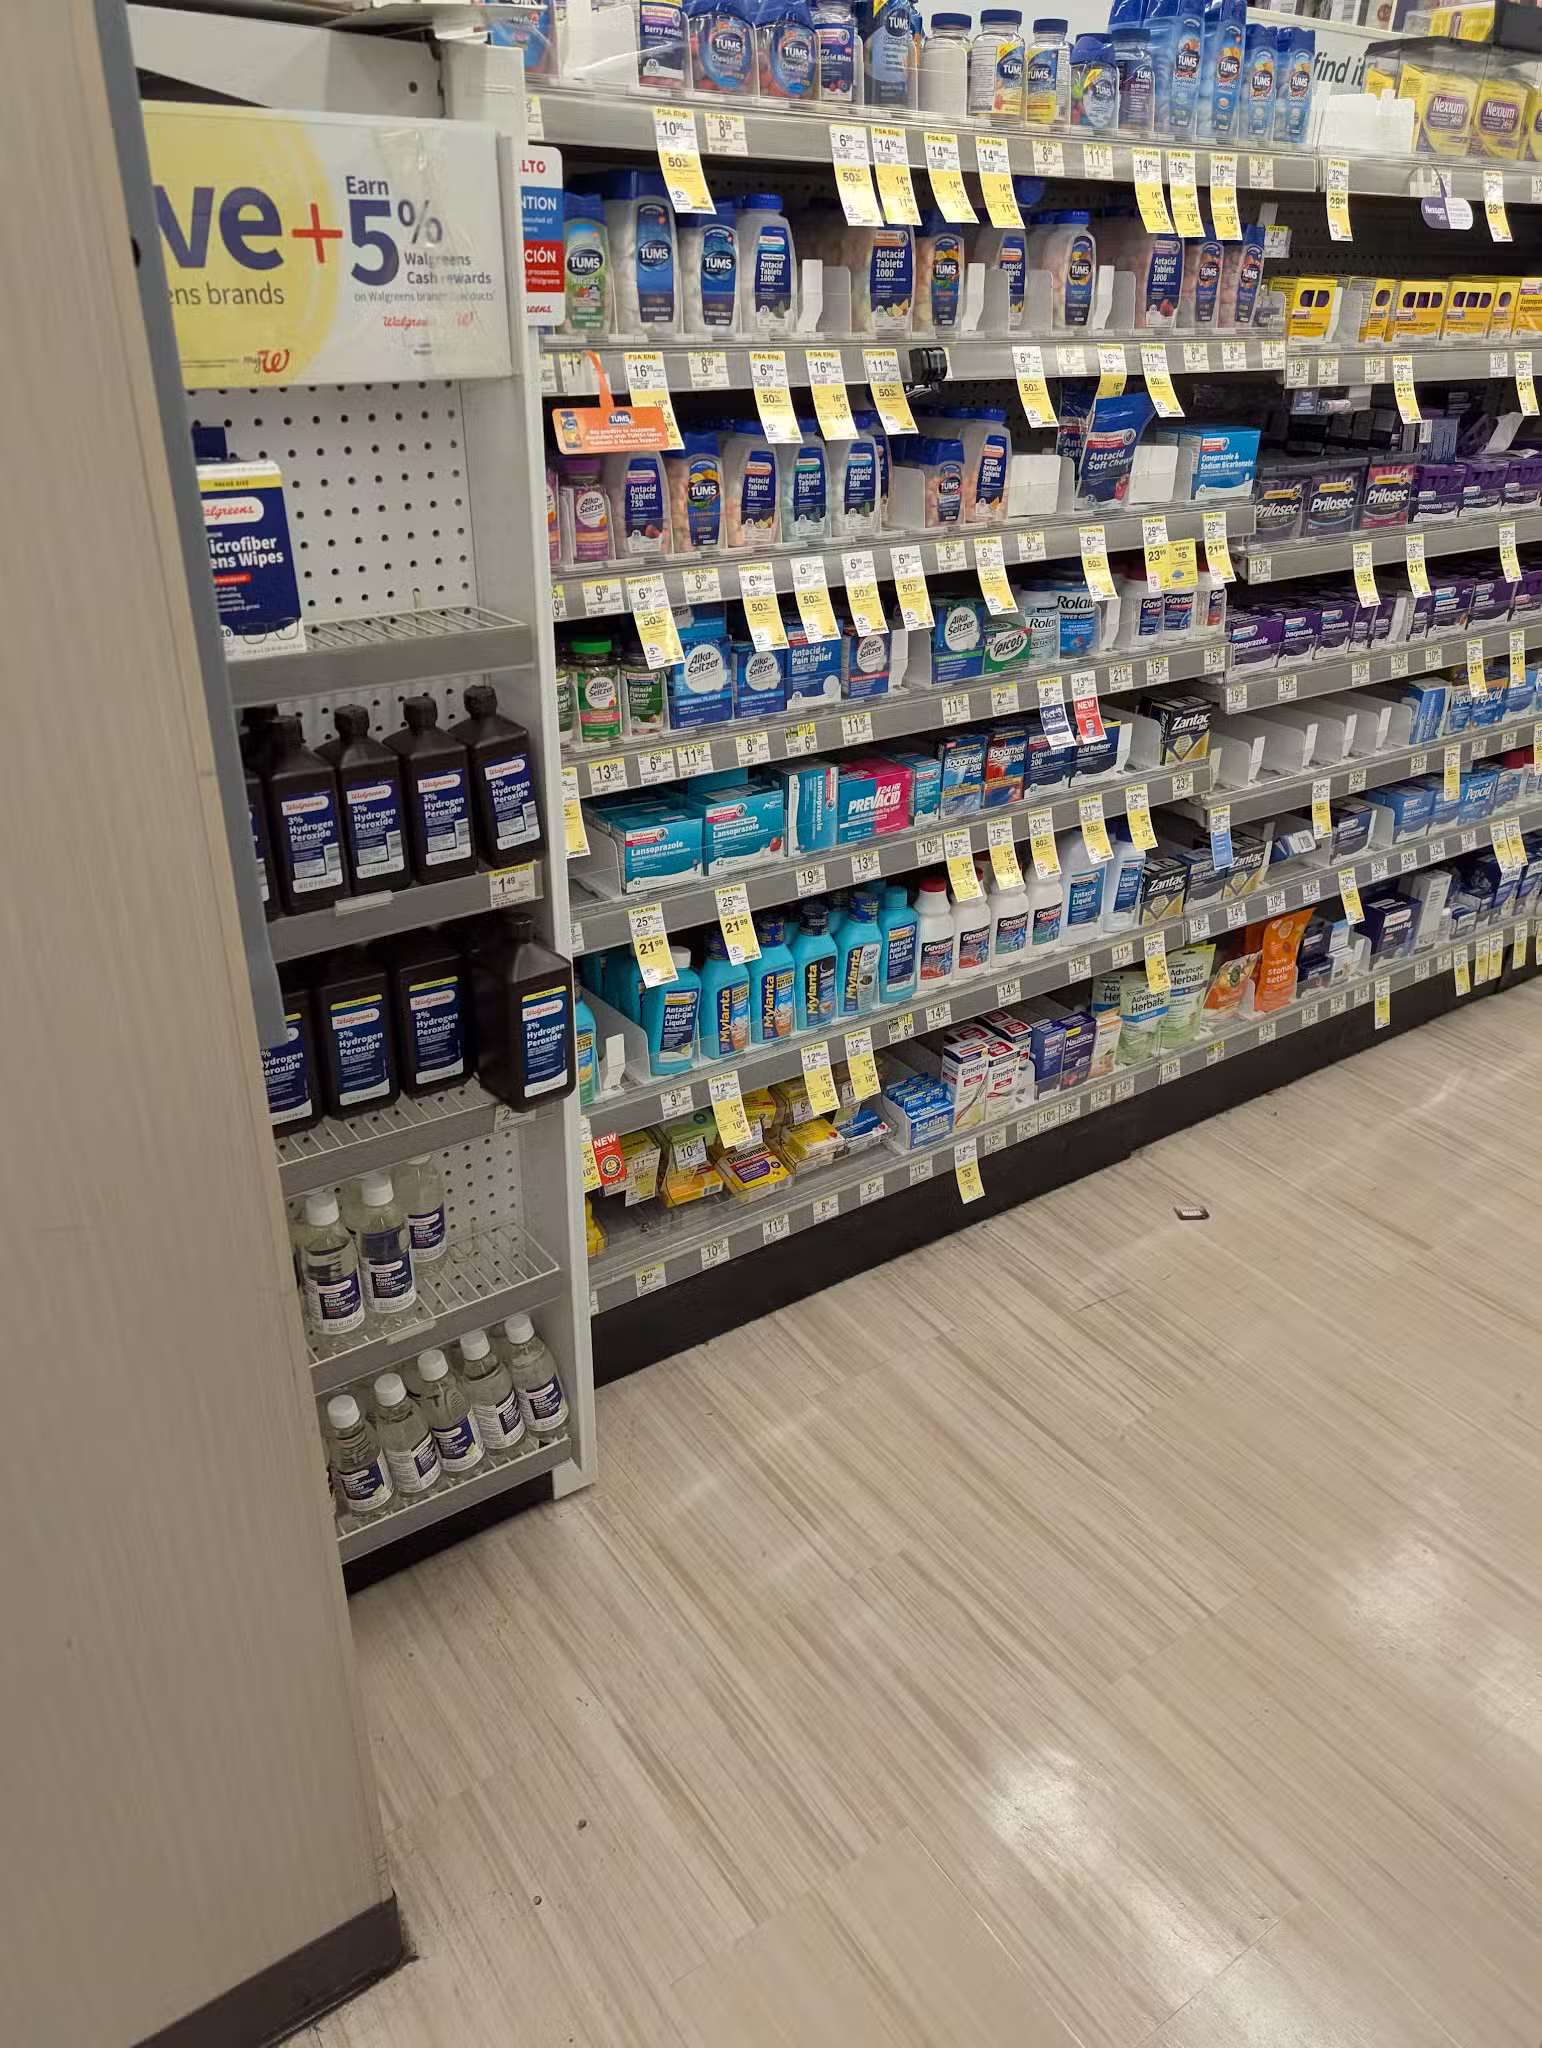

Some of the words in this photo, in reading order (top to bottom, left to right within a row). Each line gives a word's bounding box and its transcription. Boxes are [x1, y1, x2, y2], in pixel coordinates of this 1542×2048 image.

[889, 17, 908, 30] TUMS
[715, 38, 741, 52] TUMS
[785, 47, 808, 59] TUMS
[1178, 55, 1197, 68] TUMS
[1314, 52, 1347, 82] find
[1003, 64, 1021, 73] TUMS
[1219, 62, 1238, 74] TUMS
[1028, 70, 1049, 80] TUMS
[1254, 77, 1270, 86] TUMS
[1292, 77, 1309, 86] TUMS
[1096, 84, 1111, 97] TUMS
[1433, 96, 1464, 114] Nexium
[1486, 101, 1515, 118] Nexium
[520, 160, 545, 173] LTO
[346, 176, 389, 196] Earn
[641, 248, 668, 259] TUMS
[876, 249, 905, 259] Antacid
[571, 256, 600, 268] TUMS
[705, 257, 732, 269] TUMS
[760, 261, 783, 269] Antacid
[876, 259, 903, 268] Tablets
[1154, 256, 1177, 266] Antacid
[760, 268, 782, 276] Tablets
[876, 269, 894, 278] 1000
[935, 264, 957, 275] TUMS
[1071, 265, 1091, 275] TUMS
[1153, 264, 1175, 274] Tablets
[1200, 266, 1217, 277] TUMS
[1242, 268, 1258, 279] TUMS
[407, 272, 438, 283] Cash
[760, 274, 775, 282] 1000
[206, 281, 285, 305] brands
[369, 293, 415, 303] Walgreens
[610, 414, 630, 423] TUMS
[1089, 449, 1125, 461] Antacid
[1201, 453, 1234, 462] Omeprazole
[1087, 460, 1107, 471] Soft
[1200, 462, 1220, 470] Sodium
[1221, 459, 1254, 468] Bicarbonate
[798, 472, 821, 480] Antacid
[691, 486, 717, 496] TUMS
[940, 482, 960, 491] TUMS
[582, 497, 600, 507] Alka-
[631, 492, 656, 500] Tablets
[1368, 489, 1408, 503] Prilosec
[579, 503, 603, 515] Seltzer
[1255, 503, 1299, 517] Prilosec
[1311, 497, 1353, 512] Prilosec
[1418, 503, 1442, 511] Omeprazole
[238, 551, 283, 568] Wipes
[951, 613, 971, 627] Alka-
[1322, 621, 1349, 631] Omeprazole
[948, 619, 974, 636] Seltzer
[1285, 628, 1313, 638] Omeprazole
[862, 641, 879, 651] Alka-
[1234, 637, 1268, 650] Omeprazole
[792, 648, 819, 657] Antacid
[859, 645, 882, 659] Seltzer
[690, 651, 714, 666] Alka-
[752, 657, 771, 668] Alka-
[792, 656, 809, 665] Pain
[810, 652, 832, 662] Relief
[687, 658, 720, 675] Seltzer
[749, 662, 775, 677] Seltzer
[589, 680, 610, 690] Alka-
[588, 686, 613, 698] Seltzer
[1078, 700, 1094, 710] NEW
[1173, 712, 1211, 731] Zantac
[988, 744, 1025, 760] Tagamet
[945, 753, 981, 769] Tagamet
[491, 780, 504, 788] 3%
[492, 780, 530, 797] Hydrogen
[494, 790, 528, 803] Peroxide
[1467, 782, 1493, 800] Pepcid
[353, 804, 367, 813] 3%
[424, 797, 464, 810] Hydrogen
[354, 808, 396, 822] Hydrogen
[425, 806, 461, 819] Peroxide
[288, 816, 303, 825] 3%
[355, 817, 393, 831] Peroxide
[289, 820, 334, 834] Hydrogen
[713, 823, 760, 838] Lansoprazole
[290, 829, 331, 843] Peroxide
[631, 841, 683, 856] Lansoprazole
[1231, 851, 1264, 867] Zantac
[1121, 874, 1138, 883] Antacid
[1149, 874, 1185, 892] Zantac
[1120, 881, 1135, 889] Liquid
[1072, 889, 1096, 900] Antacid
[1072, 896, 1092, 906] Liquid
[889, 944, 913, 954] Anti-Gas
[889, 950, 907, 960] Liquid
[1170, 964, 1203, 976] Advanced
[1170, 972, 1203, 986] Herbals
[807, 964, 818, 1014] Mylanta
[764, 975, 775, 1028] Mylanta
[1131, 996, 1165, 1014] Herbals
[666, 1005, 692, 1013] Antacid
[415, 1011, 430, 1020] 3%
[416, 1012, 458, 1028] Hydrogen
[665, 1012, 694, 1020] Anti-Gas
[720, 990, 731, 1042] Mylanta
[526, 1022, 539, 1031] 3%
[665, 1018, 686, 1027] Liquid
[338, 1030, 353, 1039] 3%
[417, 1021, 455, 1037] Peroxide
[526, 1023, 565, 1040] Hydrogen
[339, 1032, 383, 1049] Hydrogen
[527, 1032, 562, 1049] Peroxide
[1066, 1033, 1094, 1048] Nauzene
[340, 1041, 380, 1056] Peroxide
[961, 1063, 987, 1076] Emetrol
[992, 1067, 1017, 1080] Emetrol
[915, 1113, 949, 1132] bonine
[593, 1133, 617, 1149] NEW
[727, 1146, 768, 1164] Dramamine
